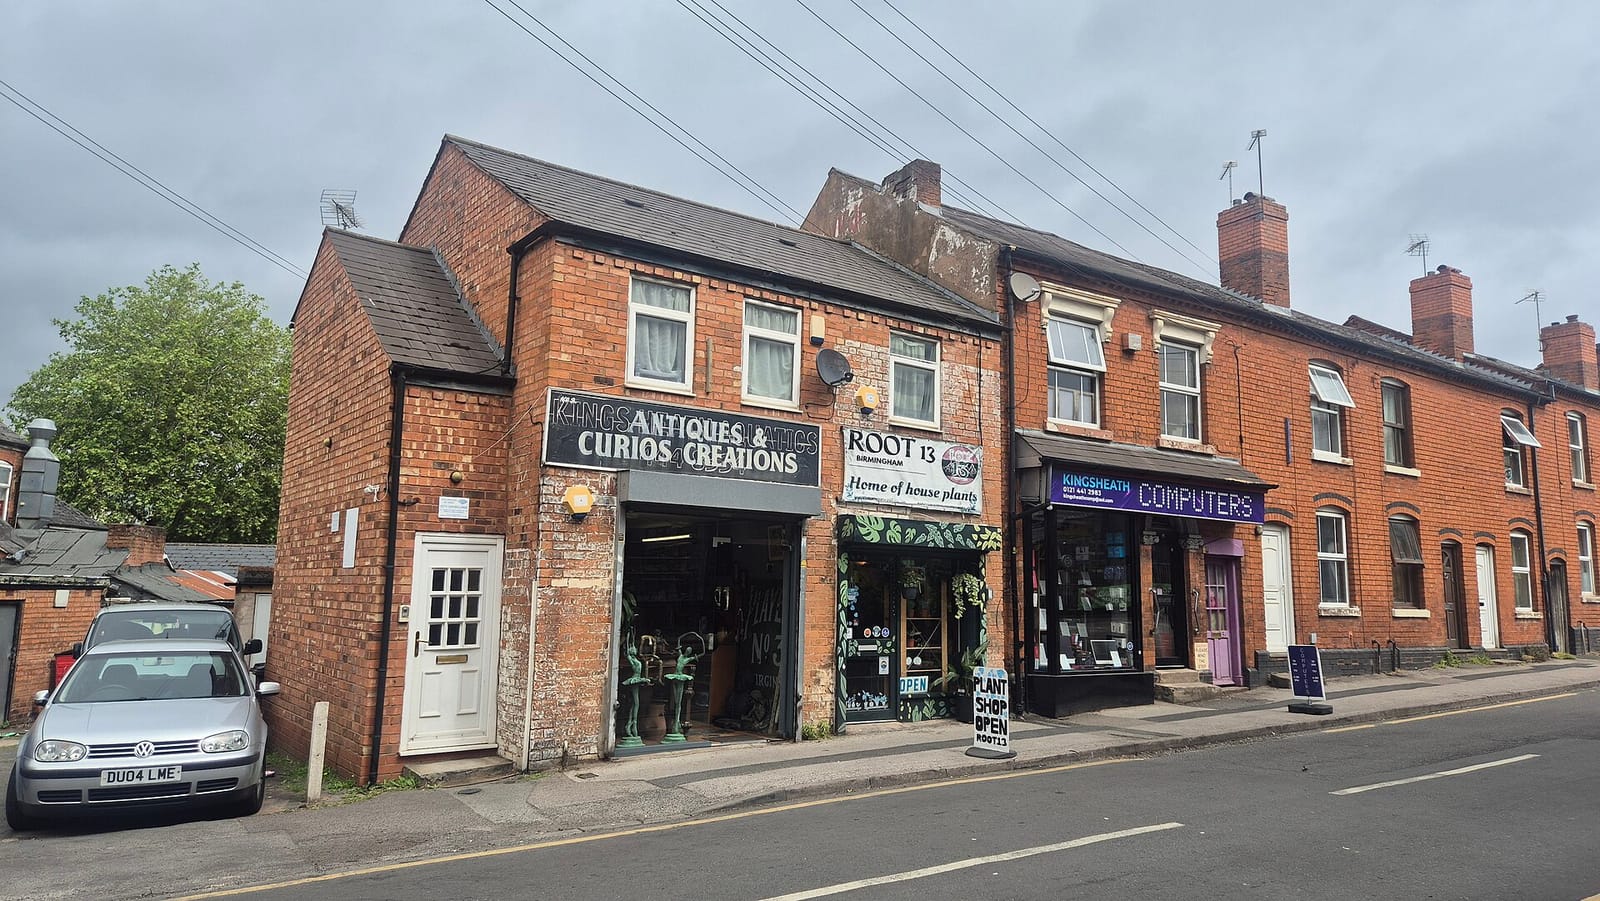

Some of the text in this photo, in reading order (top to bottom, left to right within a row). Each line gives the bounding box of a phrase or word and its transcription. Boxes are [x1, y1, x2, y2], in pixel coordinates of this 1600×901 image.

[628, 409, 744, 446] ANTIQUES
[753, 427, 767, 448] &
[578, 430, 672, 463] CURIOS
[683, 441, 799, 474] CREATIONS
[848, 430, 916, 458] ROOT
[920, 445, 936, 463] 13
[856, 454, 904, 467] BIRMINGHAM
[850, 476, 978, 502] Home of house plants
[1063, 473, 1252, 518] KINGSHEATH COMPUTERS
[900, 677, 927, 692] OPEN
[973, 676, 1007, 695] PLANT
[976, 696, 1007, 716] SHOP
[976, 716, 1008, 736] OPEN
[976, 733, 1007, 746] ROOT13
[107, 767, 176, 783] DU04 LME
